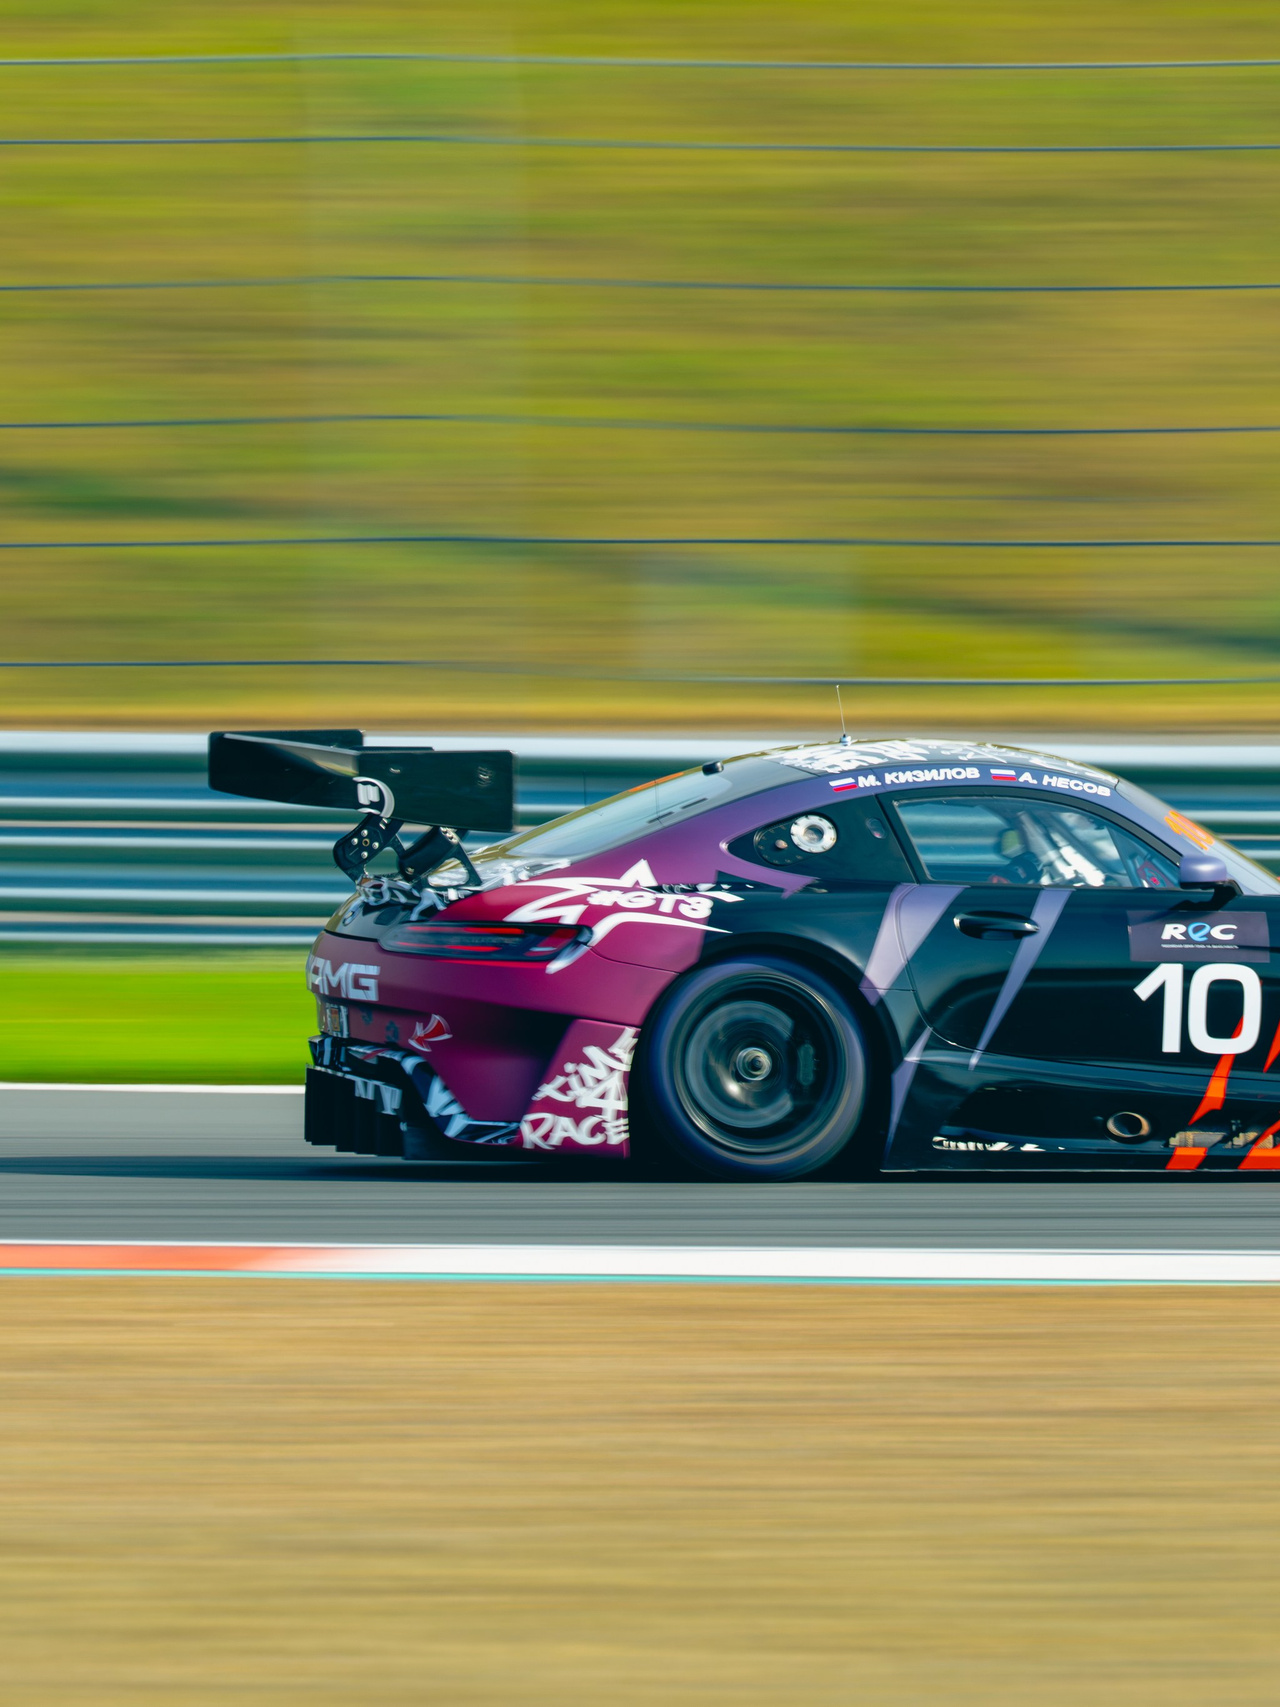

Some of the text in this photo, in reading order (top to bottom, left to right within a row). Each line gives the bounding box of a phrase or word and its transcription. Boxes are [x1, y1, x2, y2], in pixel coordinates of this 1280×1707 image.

[884, 767, 980, 785] КИЗИЛОВ
[1042, 774, 1111, 797] НЕСОВ
[309, 955, 381, 1002] AMG
[1133, 963, 1262, 1055] 10
[519, 1112, 630, 1150] RACE
